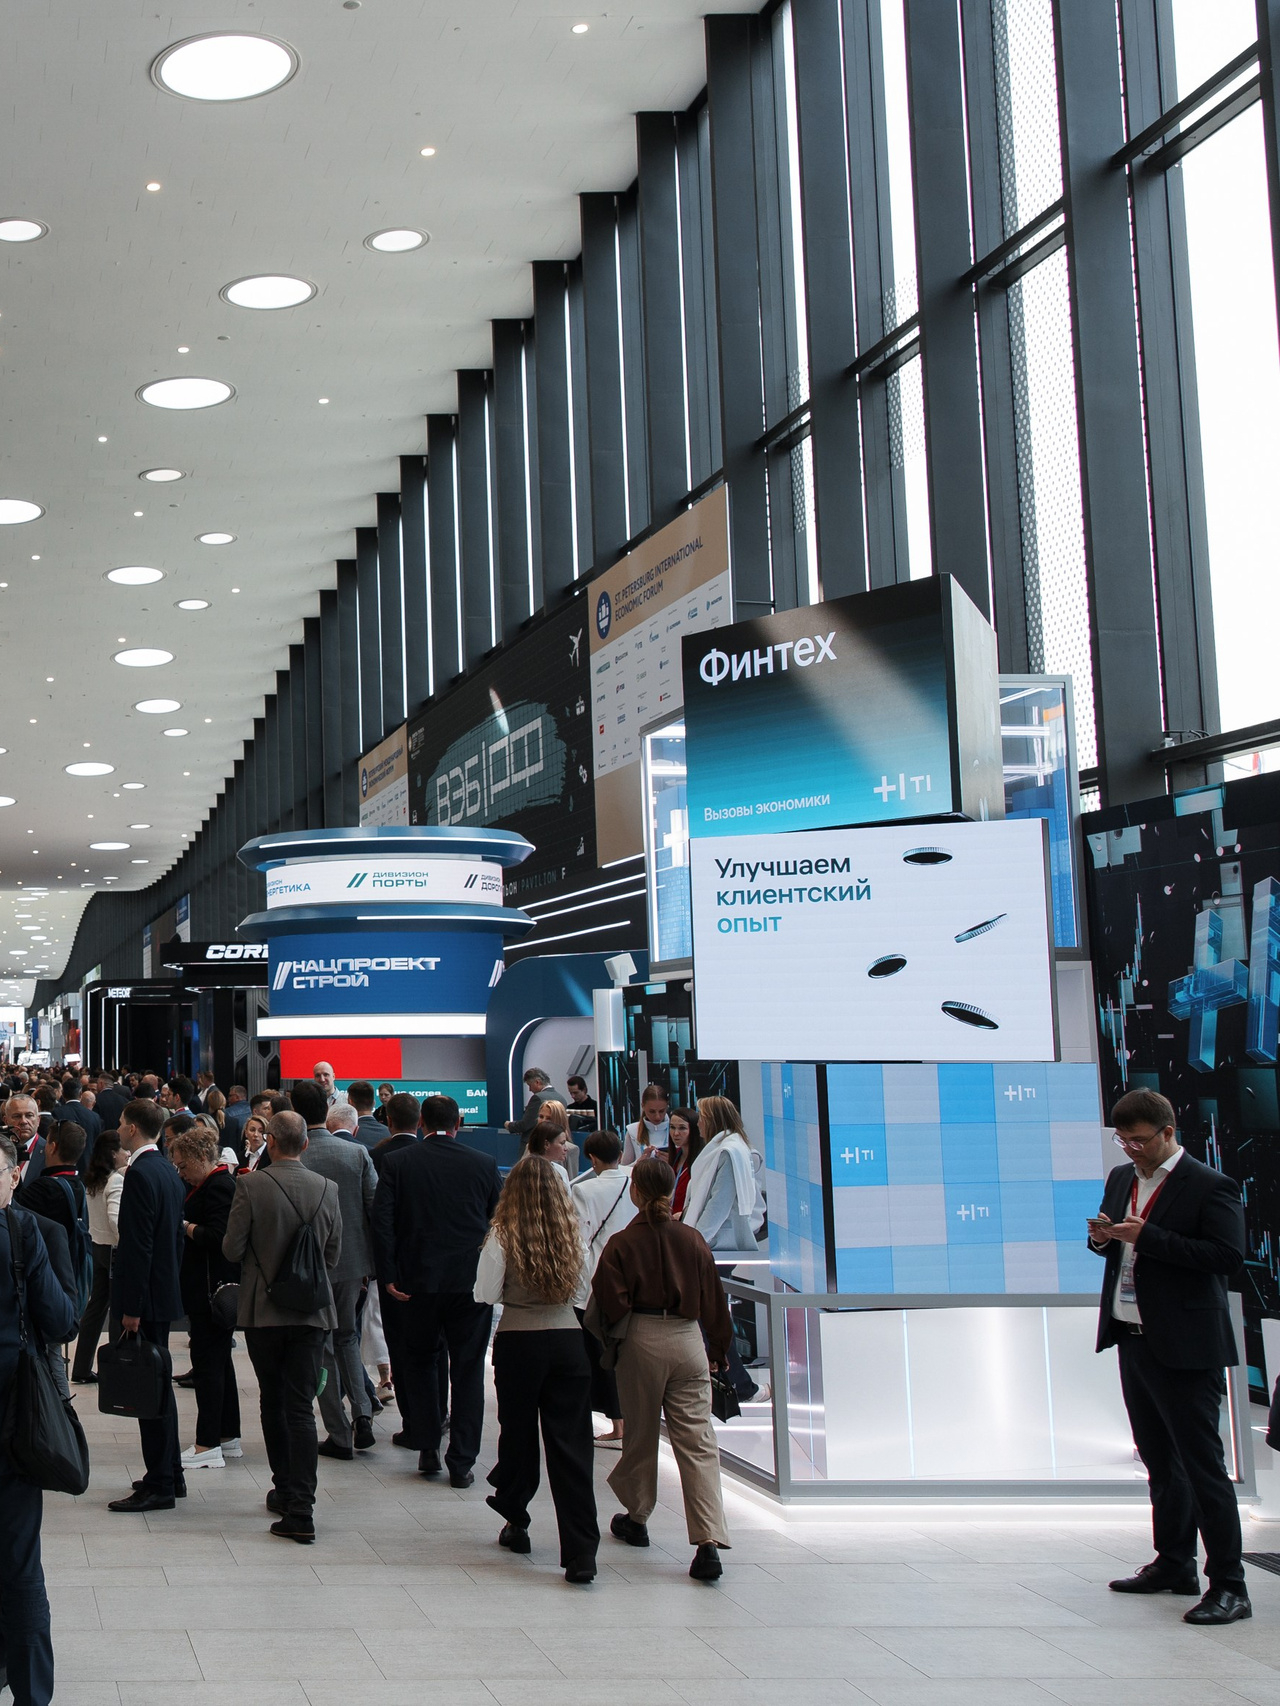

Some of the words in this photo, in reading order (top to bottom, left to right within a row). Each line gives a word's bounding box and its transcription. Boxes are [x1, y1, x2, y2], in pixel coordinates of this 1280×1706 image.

[622, 569, 655, 600] PETERSBURG
[655, 536, 703, 576] INTERNATIONAL
[615, 593, 642, 621] ECONOMIC
[643, 580, 664, 603] FORUM
[699, 631, 837, 686] Финтех
[704, 803, 753, 821] Вызовы
[756, 794, 831, 814] экономики
[521, 869, 557, 892] PAVILION
[561, 867, 566, 880] F
[714, 857, 851, 883] Улучшаем
[373, 879, 427, 887] ПОРТЫ
[716, 878, 872, 906] клиентский
[717, 916, 782, 934] опыт
[293, 957, 441, 974] НАЦПРОЕКТ
[108, 988, 131, 998] METEOR
[293, 972, 369, 989] СТРОЙ
